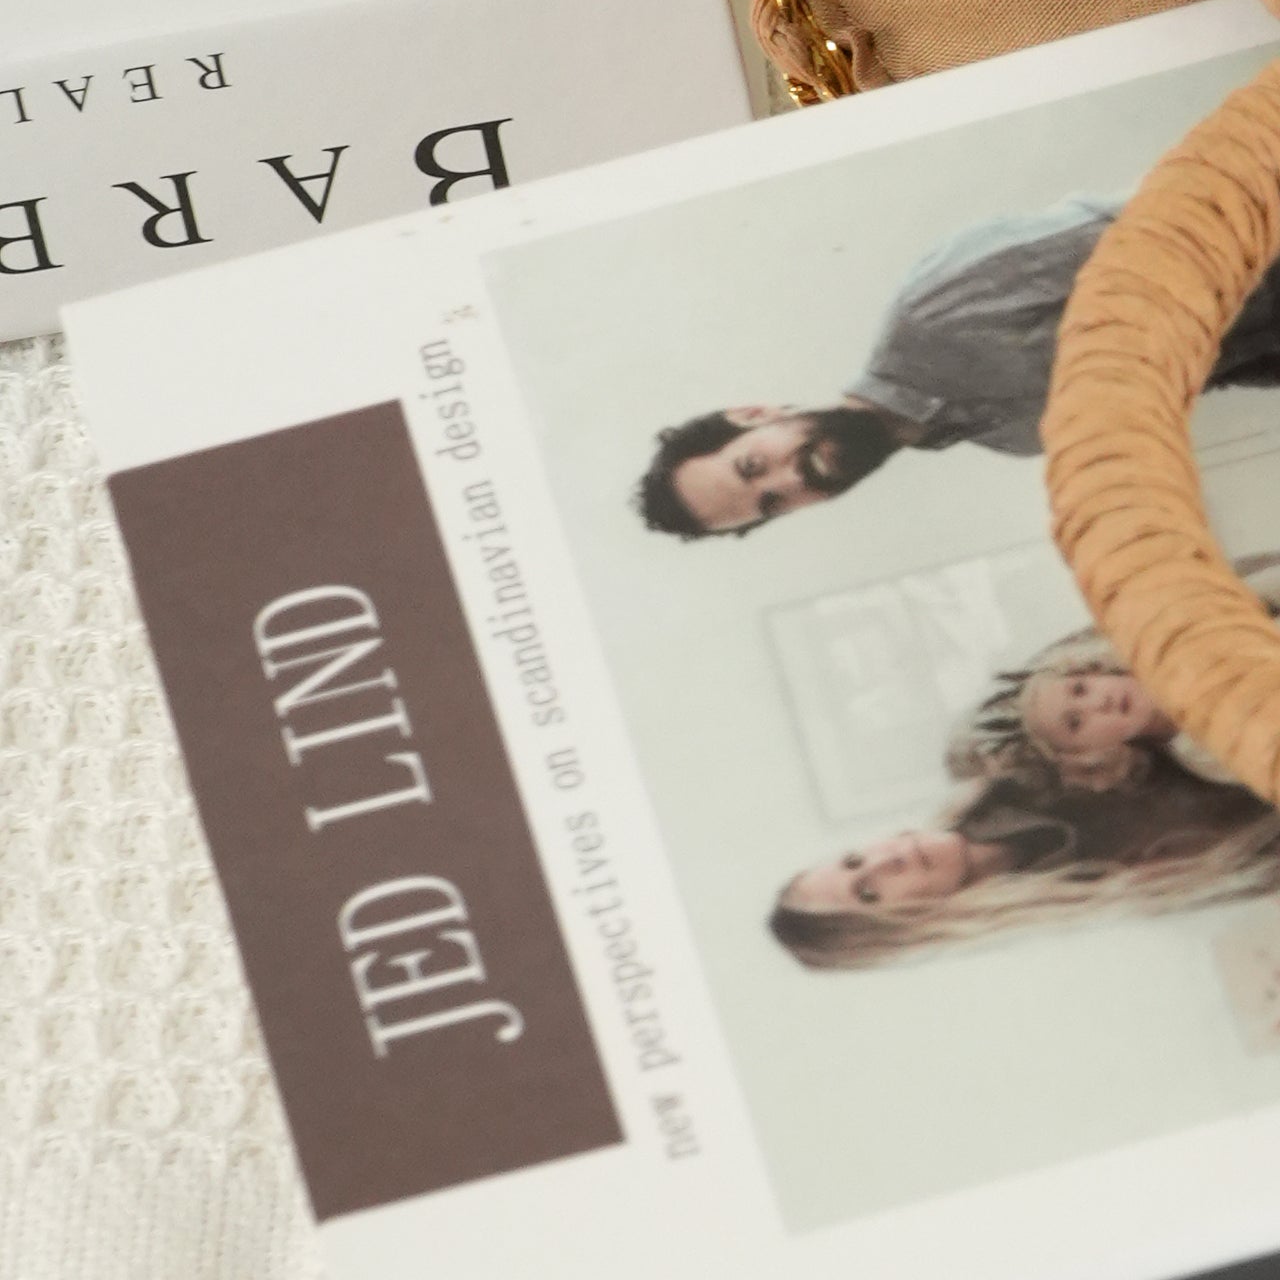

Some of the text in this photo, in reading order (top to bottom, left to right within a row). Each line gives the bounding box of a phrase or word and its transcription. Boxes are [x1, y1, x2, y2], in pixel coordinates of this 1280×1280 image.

[252, 584, 524, 1058] JED LIND
[418, 337, 700, 1161] new perspectives on scandinavian design
